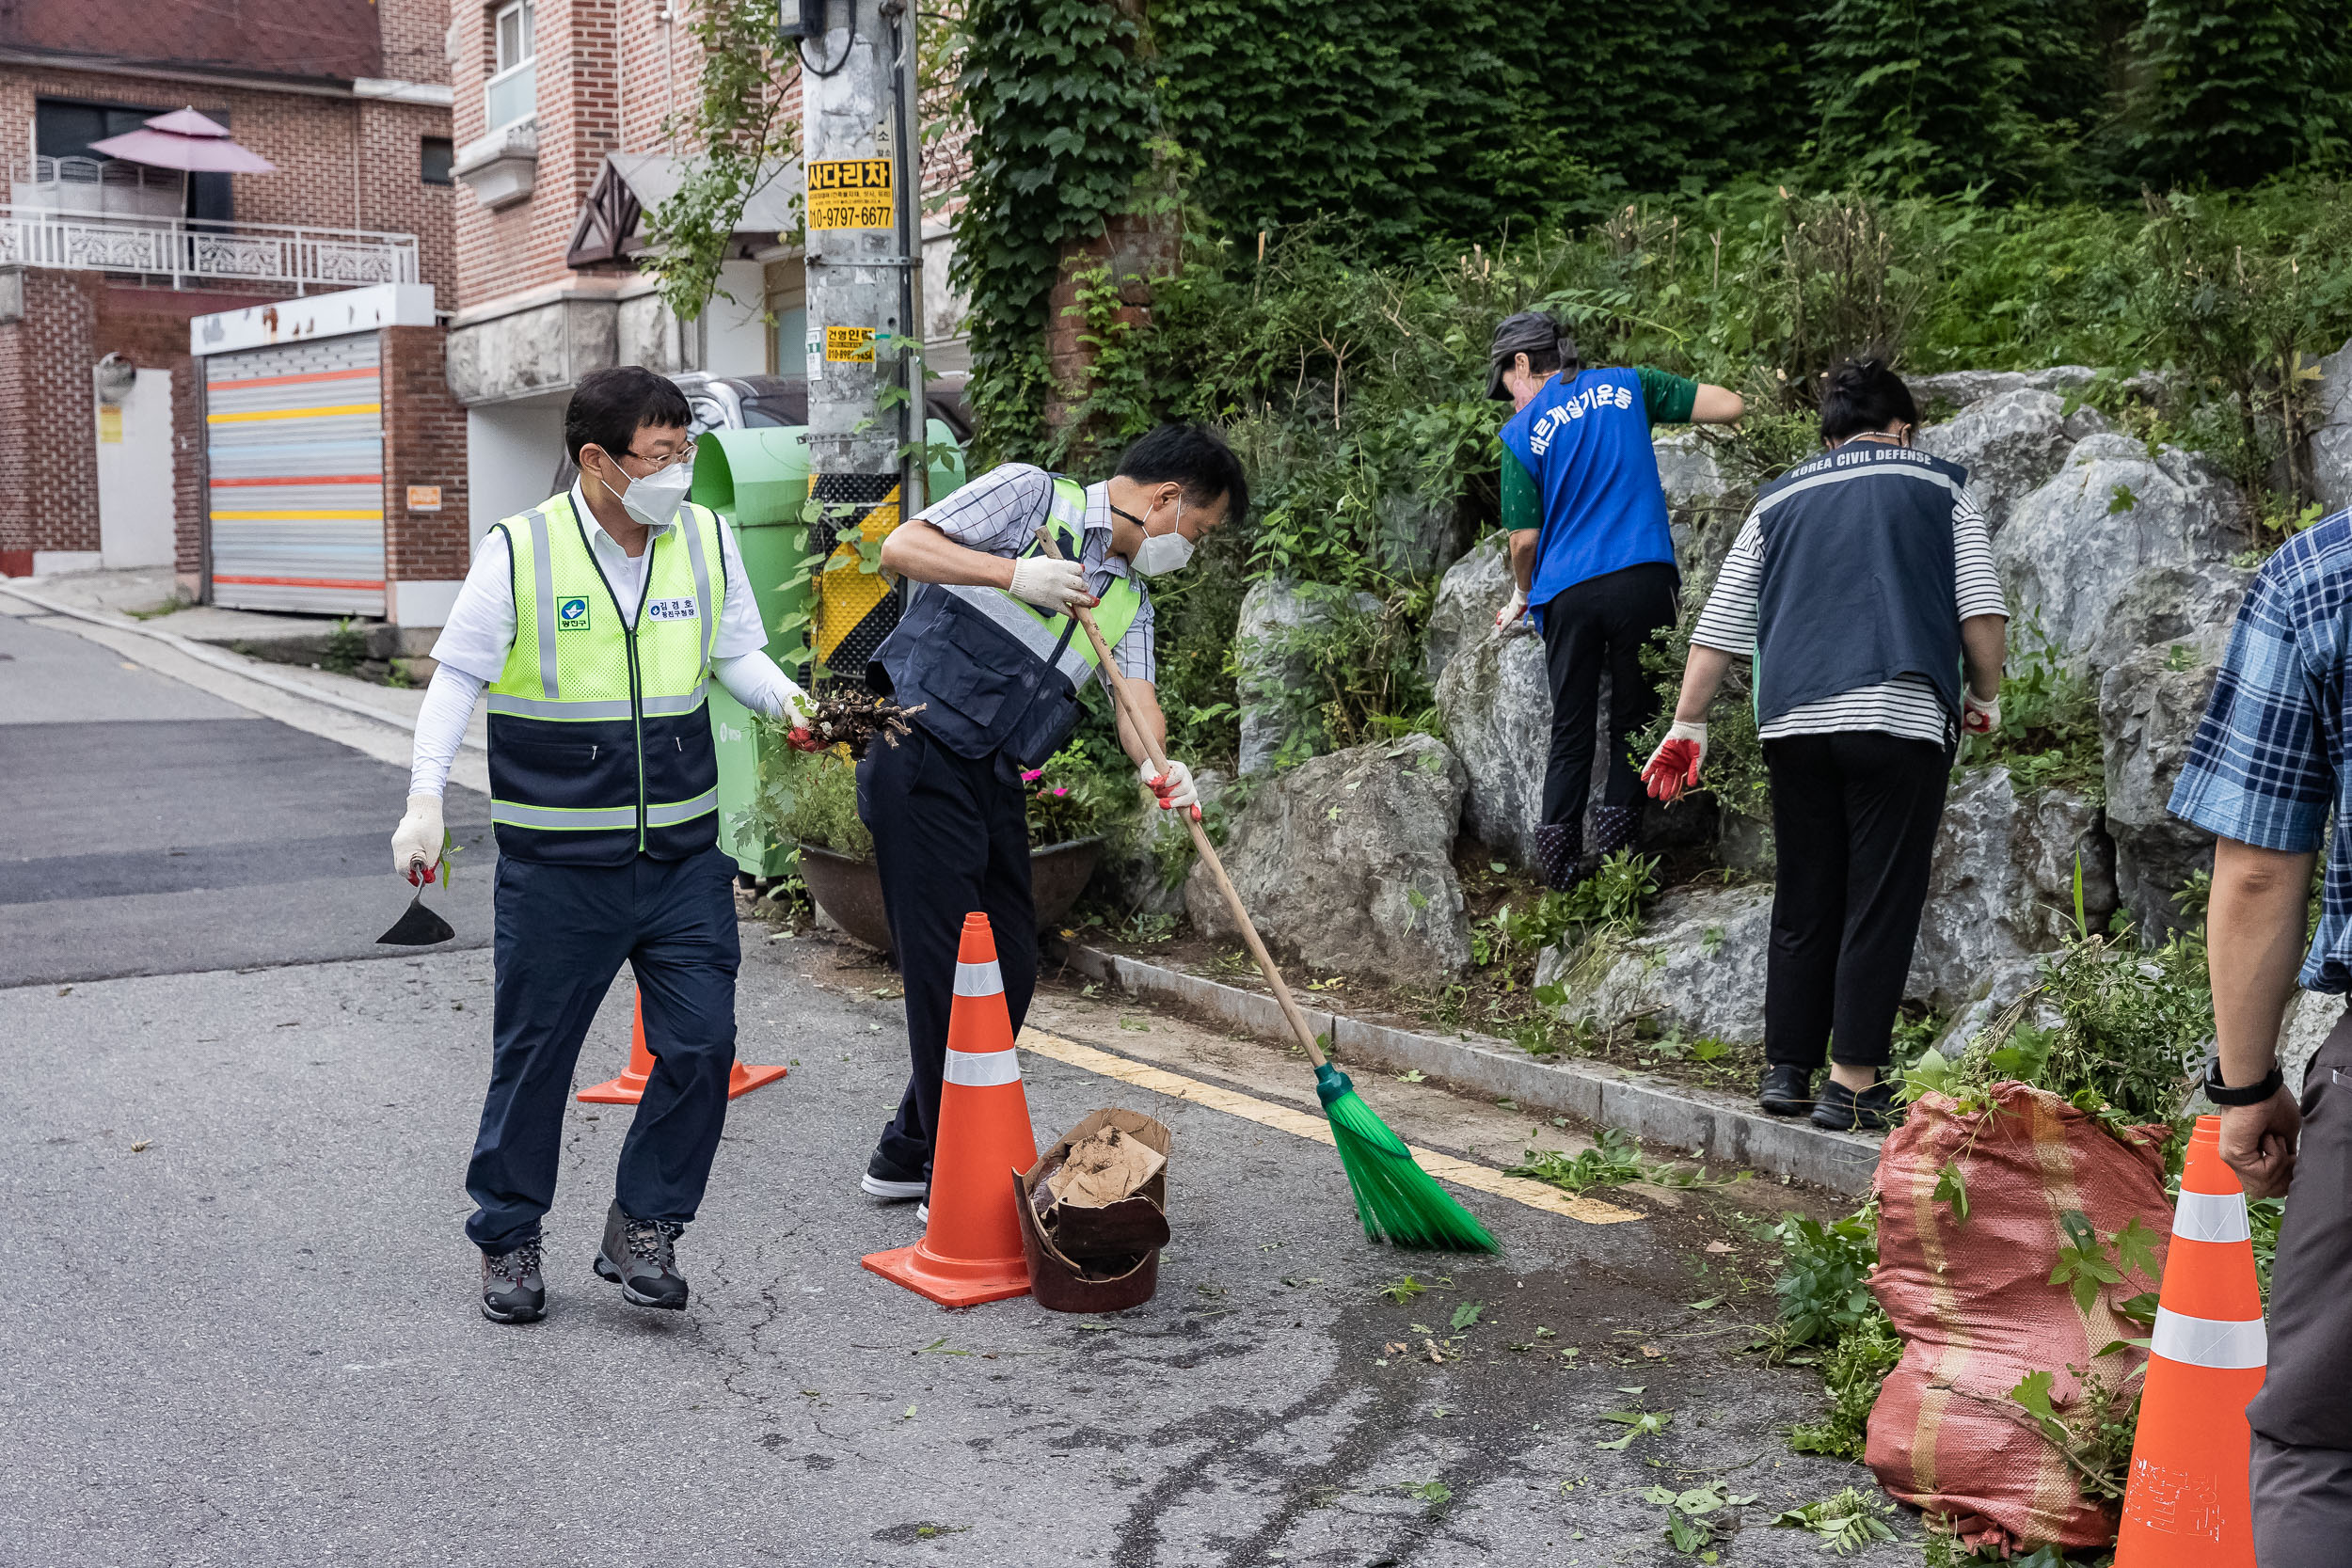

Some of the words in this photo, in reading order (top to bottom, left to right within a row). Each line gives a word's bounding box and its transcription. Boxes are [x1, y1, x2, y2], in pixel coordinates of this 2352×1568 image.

[808, 162, 888, 190] 사다리차
[808, 206, 891, 230] 010-9797-6677
[1530, 383, 1633, 456] 바르게살기운동
[1790, 456, 1833, 479] KOREA
[1836, 450, 1872, 467] CIVIL
[1875, 449, 1931, 466] DEFENSE
[561, 620, 587, 628] 광진구
